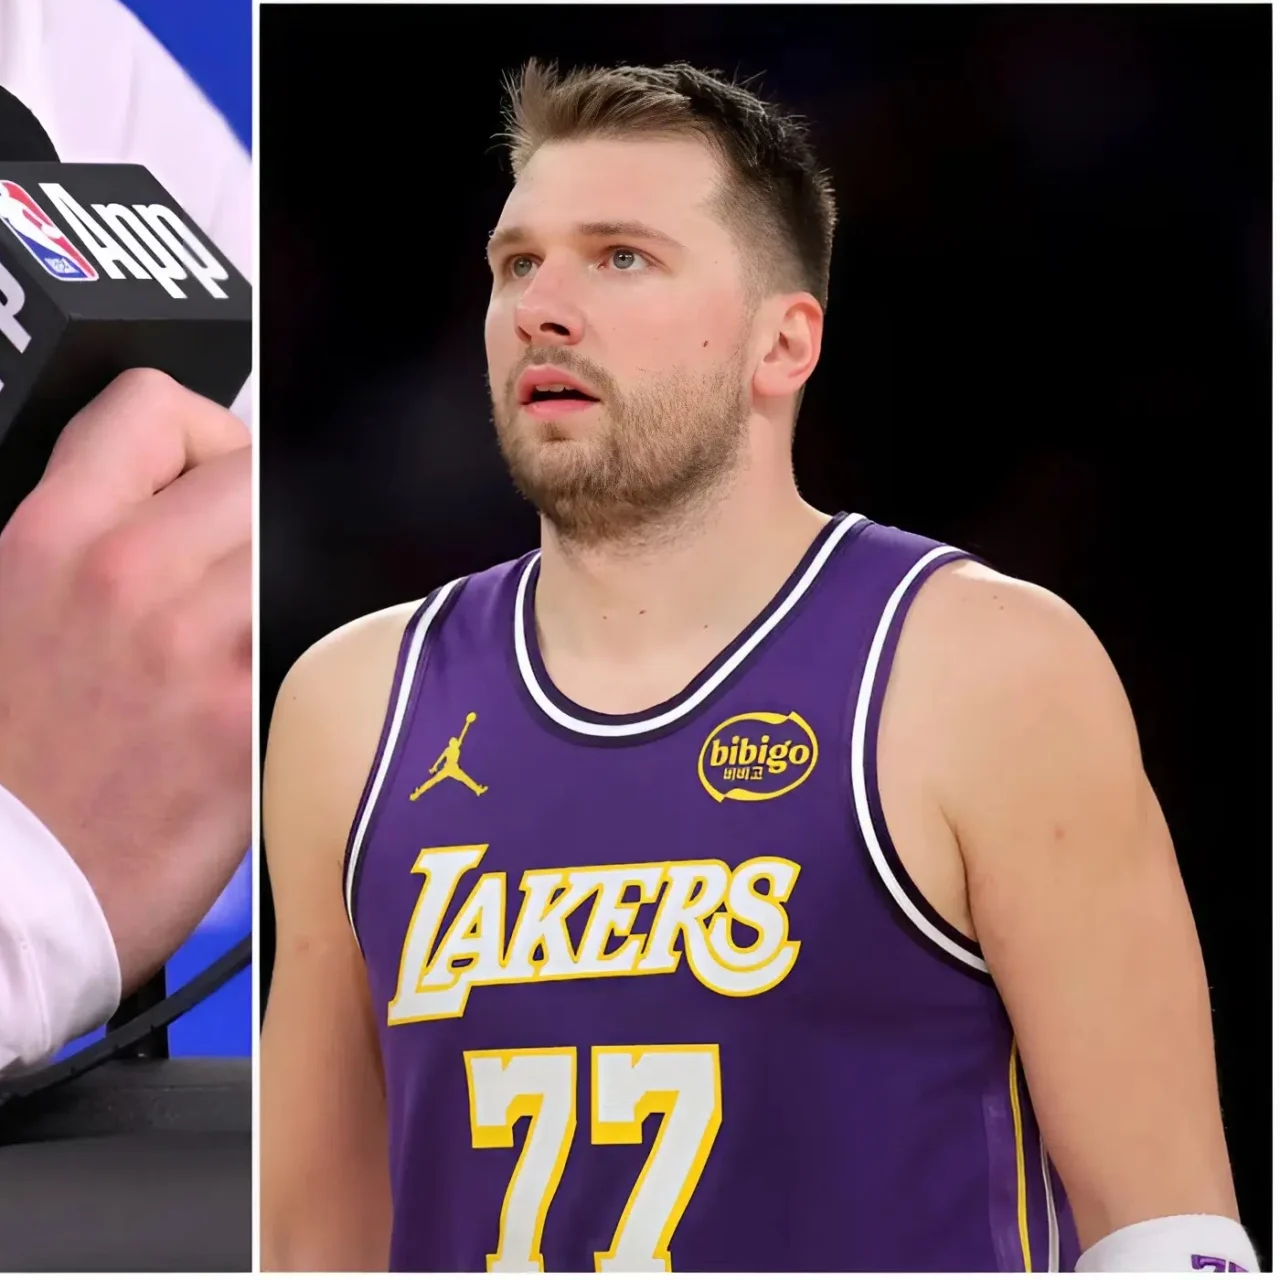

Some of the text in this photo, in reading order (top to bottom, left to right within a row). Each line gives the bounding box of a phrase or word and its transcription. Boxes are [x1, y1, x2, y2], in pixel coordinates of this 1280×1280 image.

[39, 183, 230, 299] App
[710, 735, 810, 774] bibigo
[723, 766, 764, 781] 비비고
[388, 844, 801, 1027] LAKERS
[463, 1043, 722, 1272] 77
